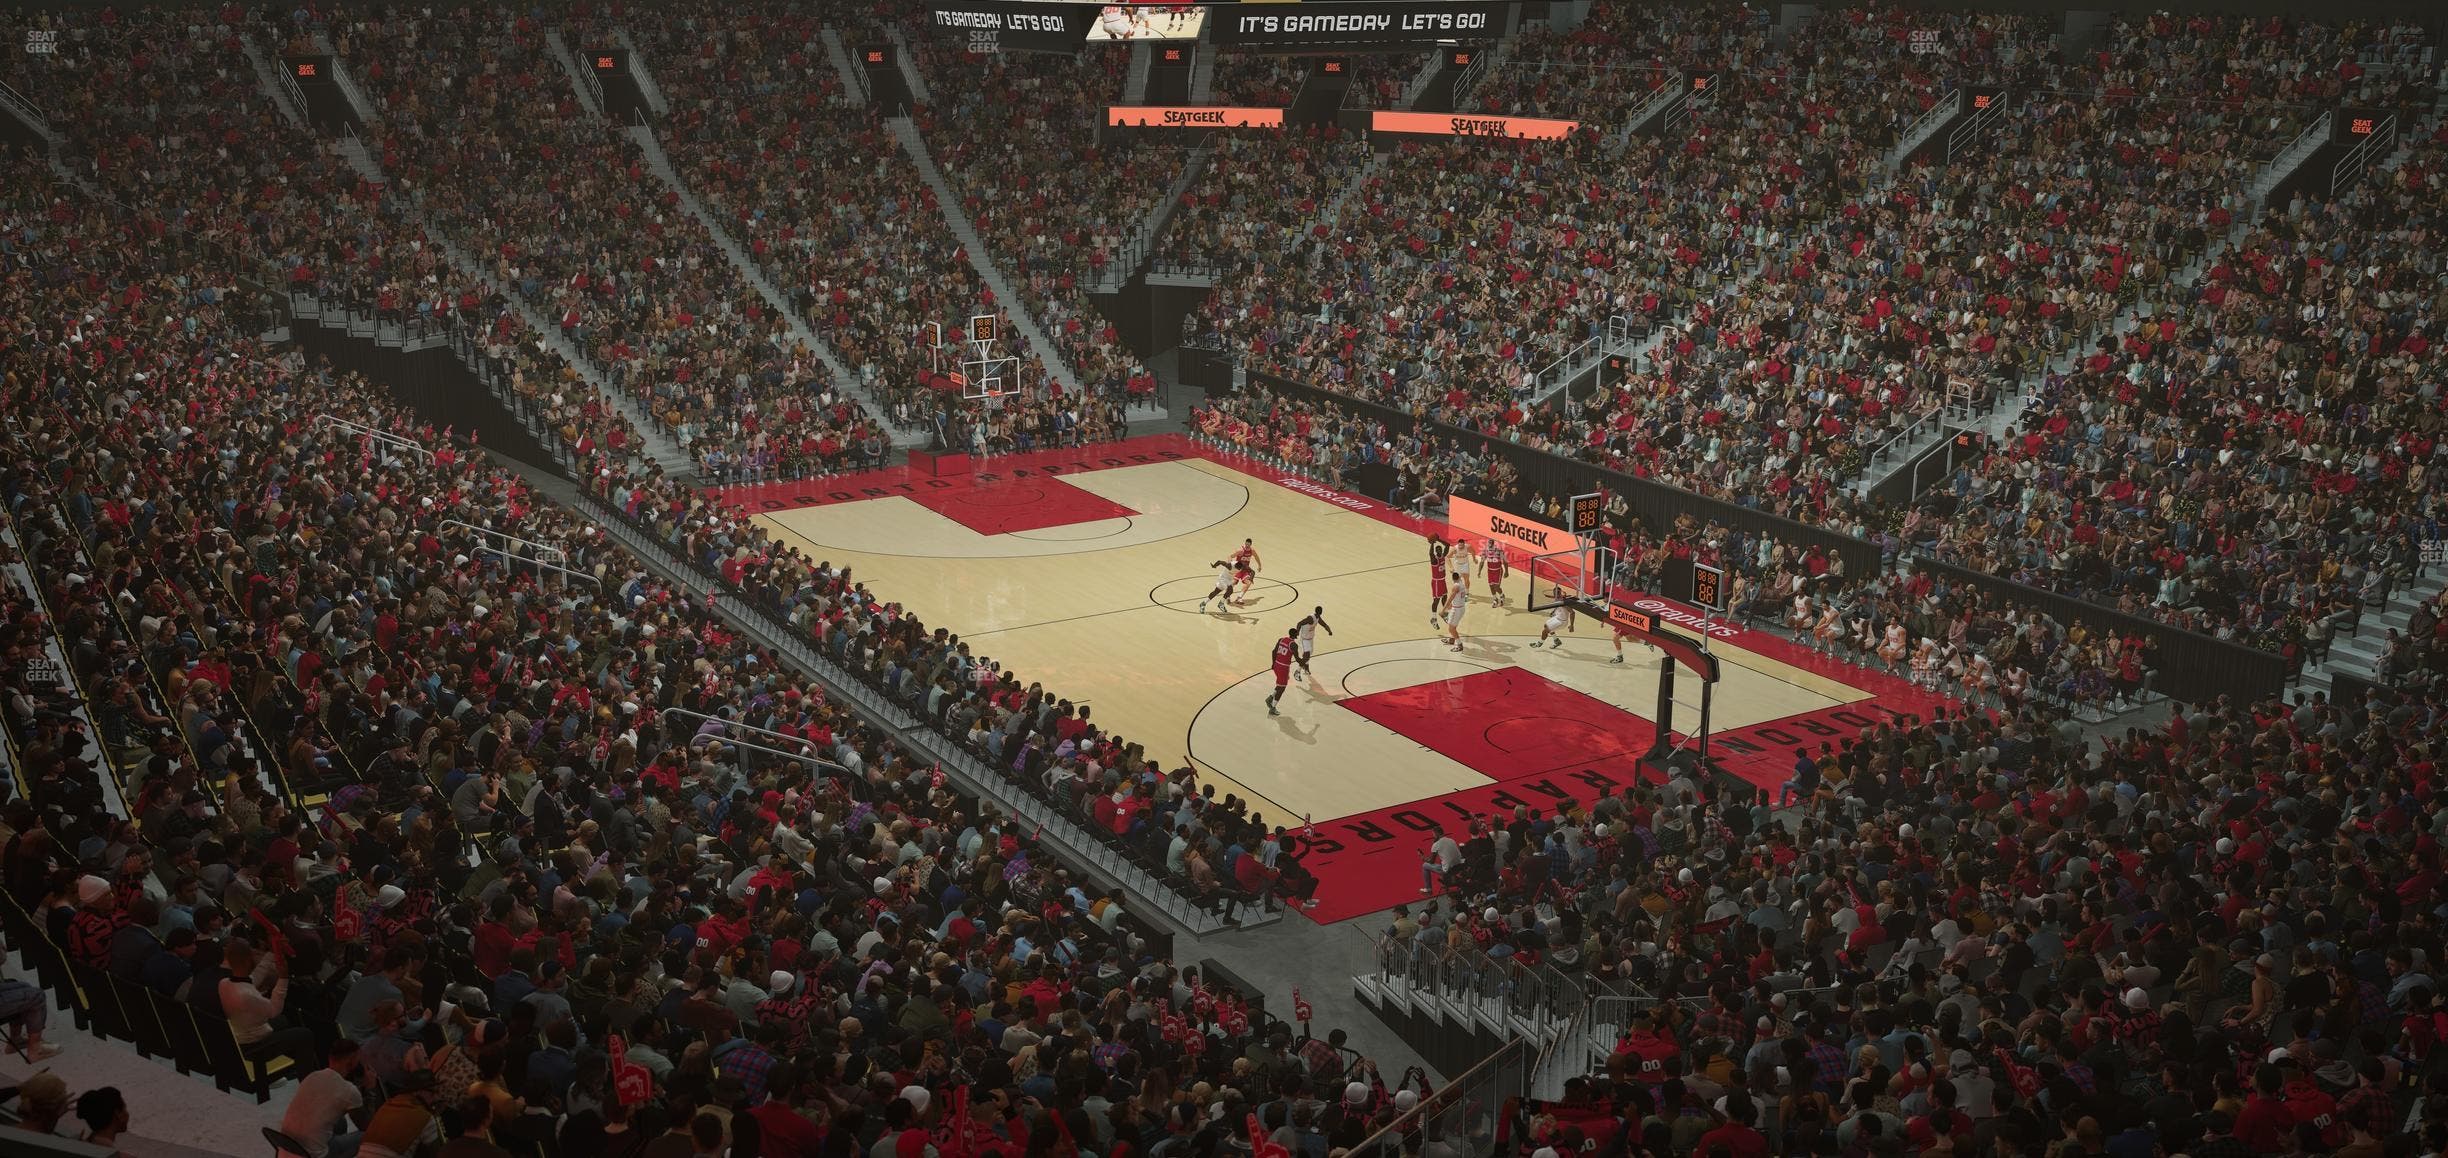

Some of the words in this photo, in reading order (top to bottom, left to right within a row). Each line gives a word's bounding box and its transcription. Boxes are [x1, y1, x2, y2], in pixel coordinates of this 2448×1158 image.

[936, 11, 951, 26] IT'S
[951, 12, 1001, 29] GAMEDAY
[1007, 14, 1040, 31] LET'S
[1042, 16, 1065, 32] GO!
[1239, 17, 1278, 33] IT'S
[1284, 15, 1391, 32] GAMEDAY
[1402, 14, 1453, 30] LET'S
[1456, 13, 1487, 28] GO!
[1164, 111, 1225, 123] SEATGEEK
[1451, 118, 1507, 133] SEATGEEK
[2352, 126, 2372, 134] GEEK
[760, 479, 953, 510] ORONTO
[975, 451, 1184, 482] RAPTORS
[1278, 478, 1374, 510] raptors.com
[1579, 510, 1596, 528] 88
[1491, 516, 1548, 550] SEATGEEK
[1699, 583, 1714, 604] 88
[1614, 608, 1646, 628] SEATGEEK
[1634, 599, 1740, 637] @raptors
[1295, 769, 1620, 858] RAPTORS
[745, 886, 756, 896] 00
[696, 938, 709, 948] 00
[1642, 1059, 1661, 1072] 00
[2313, 1113, 2332, 1130] 00
